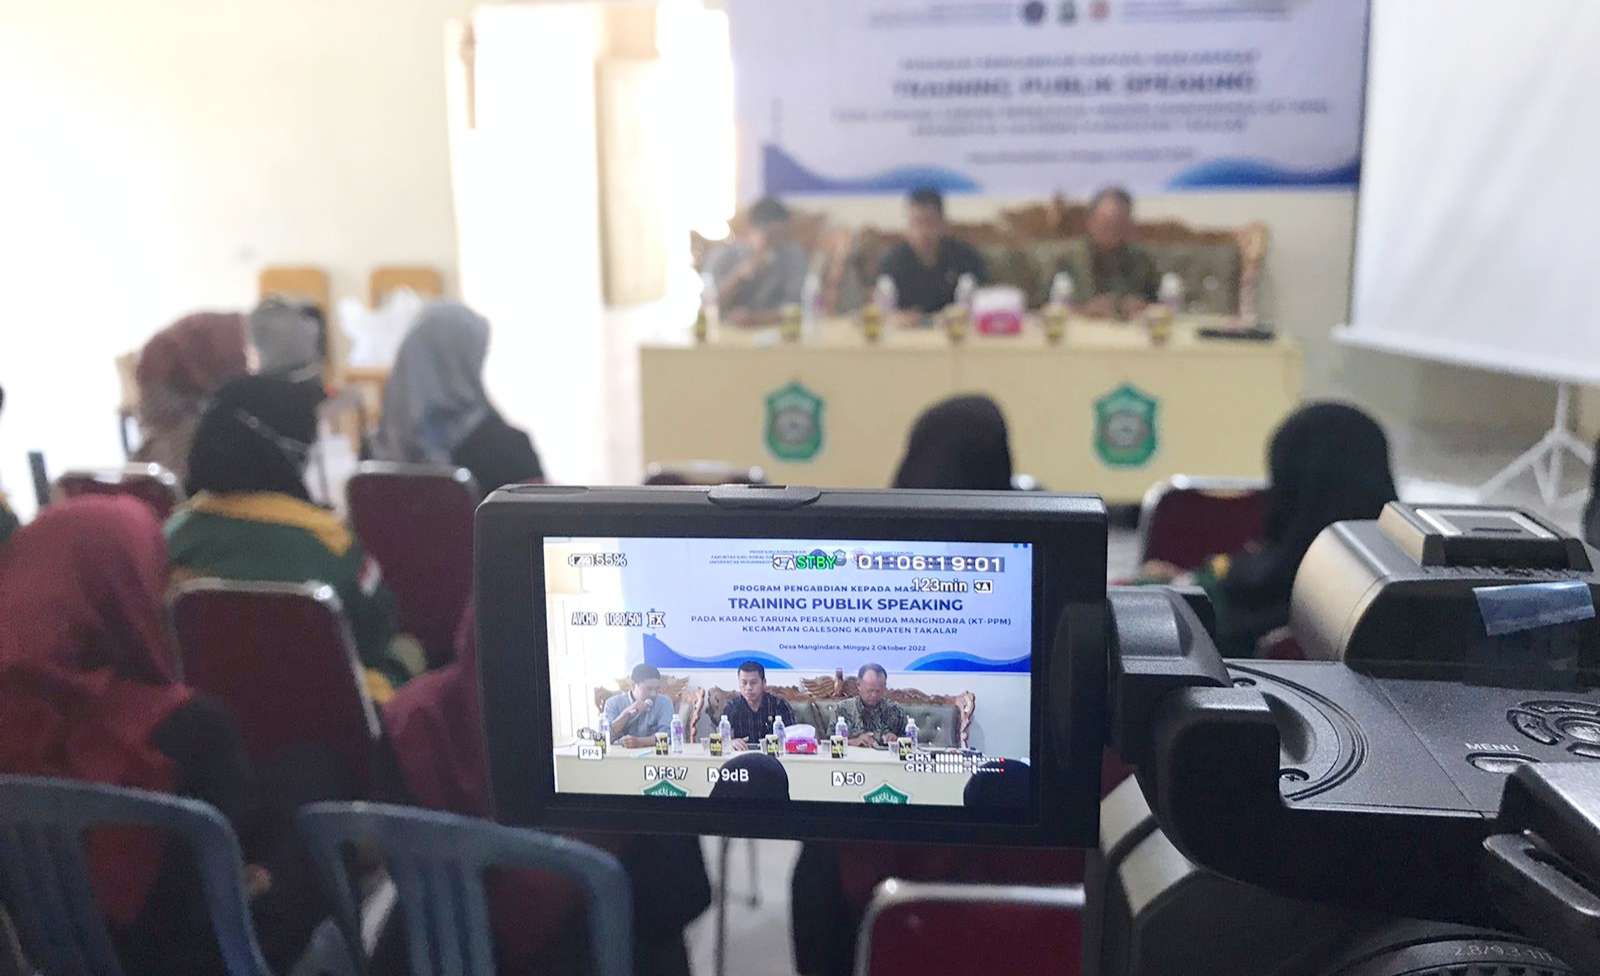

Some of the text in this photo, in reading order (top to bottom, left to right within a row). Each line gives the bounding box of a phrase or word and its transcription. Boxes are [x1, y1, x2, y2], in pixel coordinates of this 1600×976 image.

[593, 553, 628, 568] 55%
[795, 554, 837, 570] STBY
[857, 554, 1003, 572] 01:06:19:01
[733, 584, 781, 592] PROGRAM
[784, 585, 848, 593] PENGABDIAN
[850, 585, 891, 593] KEPADA
[912, 577, 968, 593] 123min
[728, 597, 963, 611] TRAINING PUBLIK SPEAKING
[858, 616, 898, 624] PEMUDA
[900, 617, 966, 625] MANGINDARA
[968, 617, 1012, 626] (KT-PPM)
[582, 748, 600, 757] PP4
[1465, 743, 1520, 752] MENU
[721, 768, 750, 783] 9dB
[904, 763, 932, 774] CH2
[845, 772, 865, 786] 50
